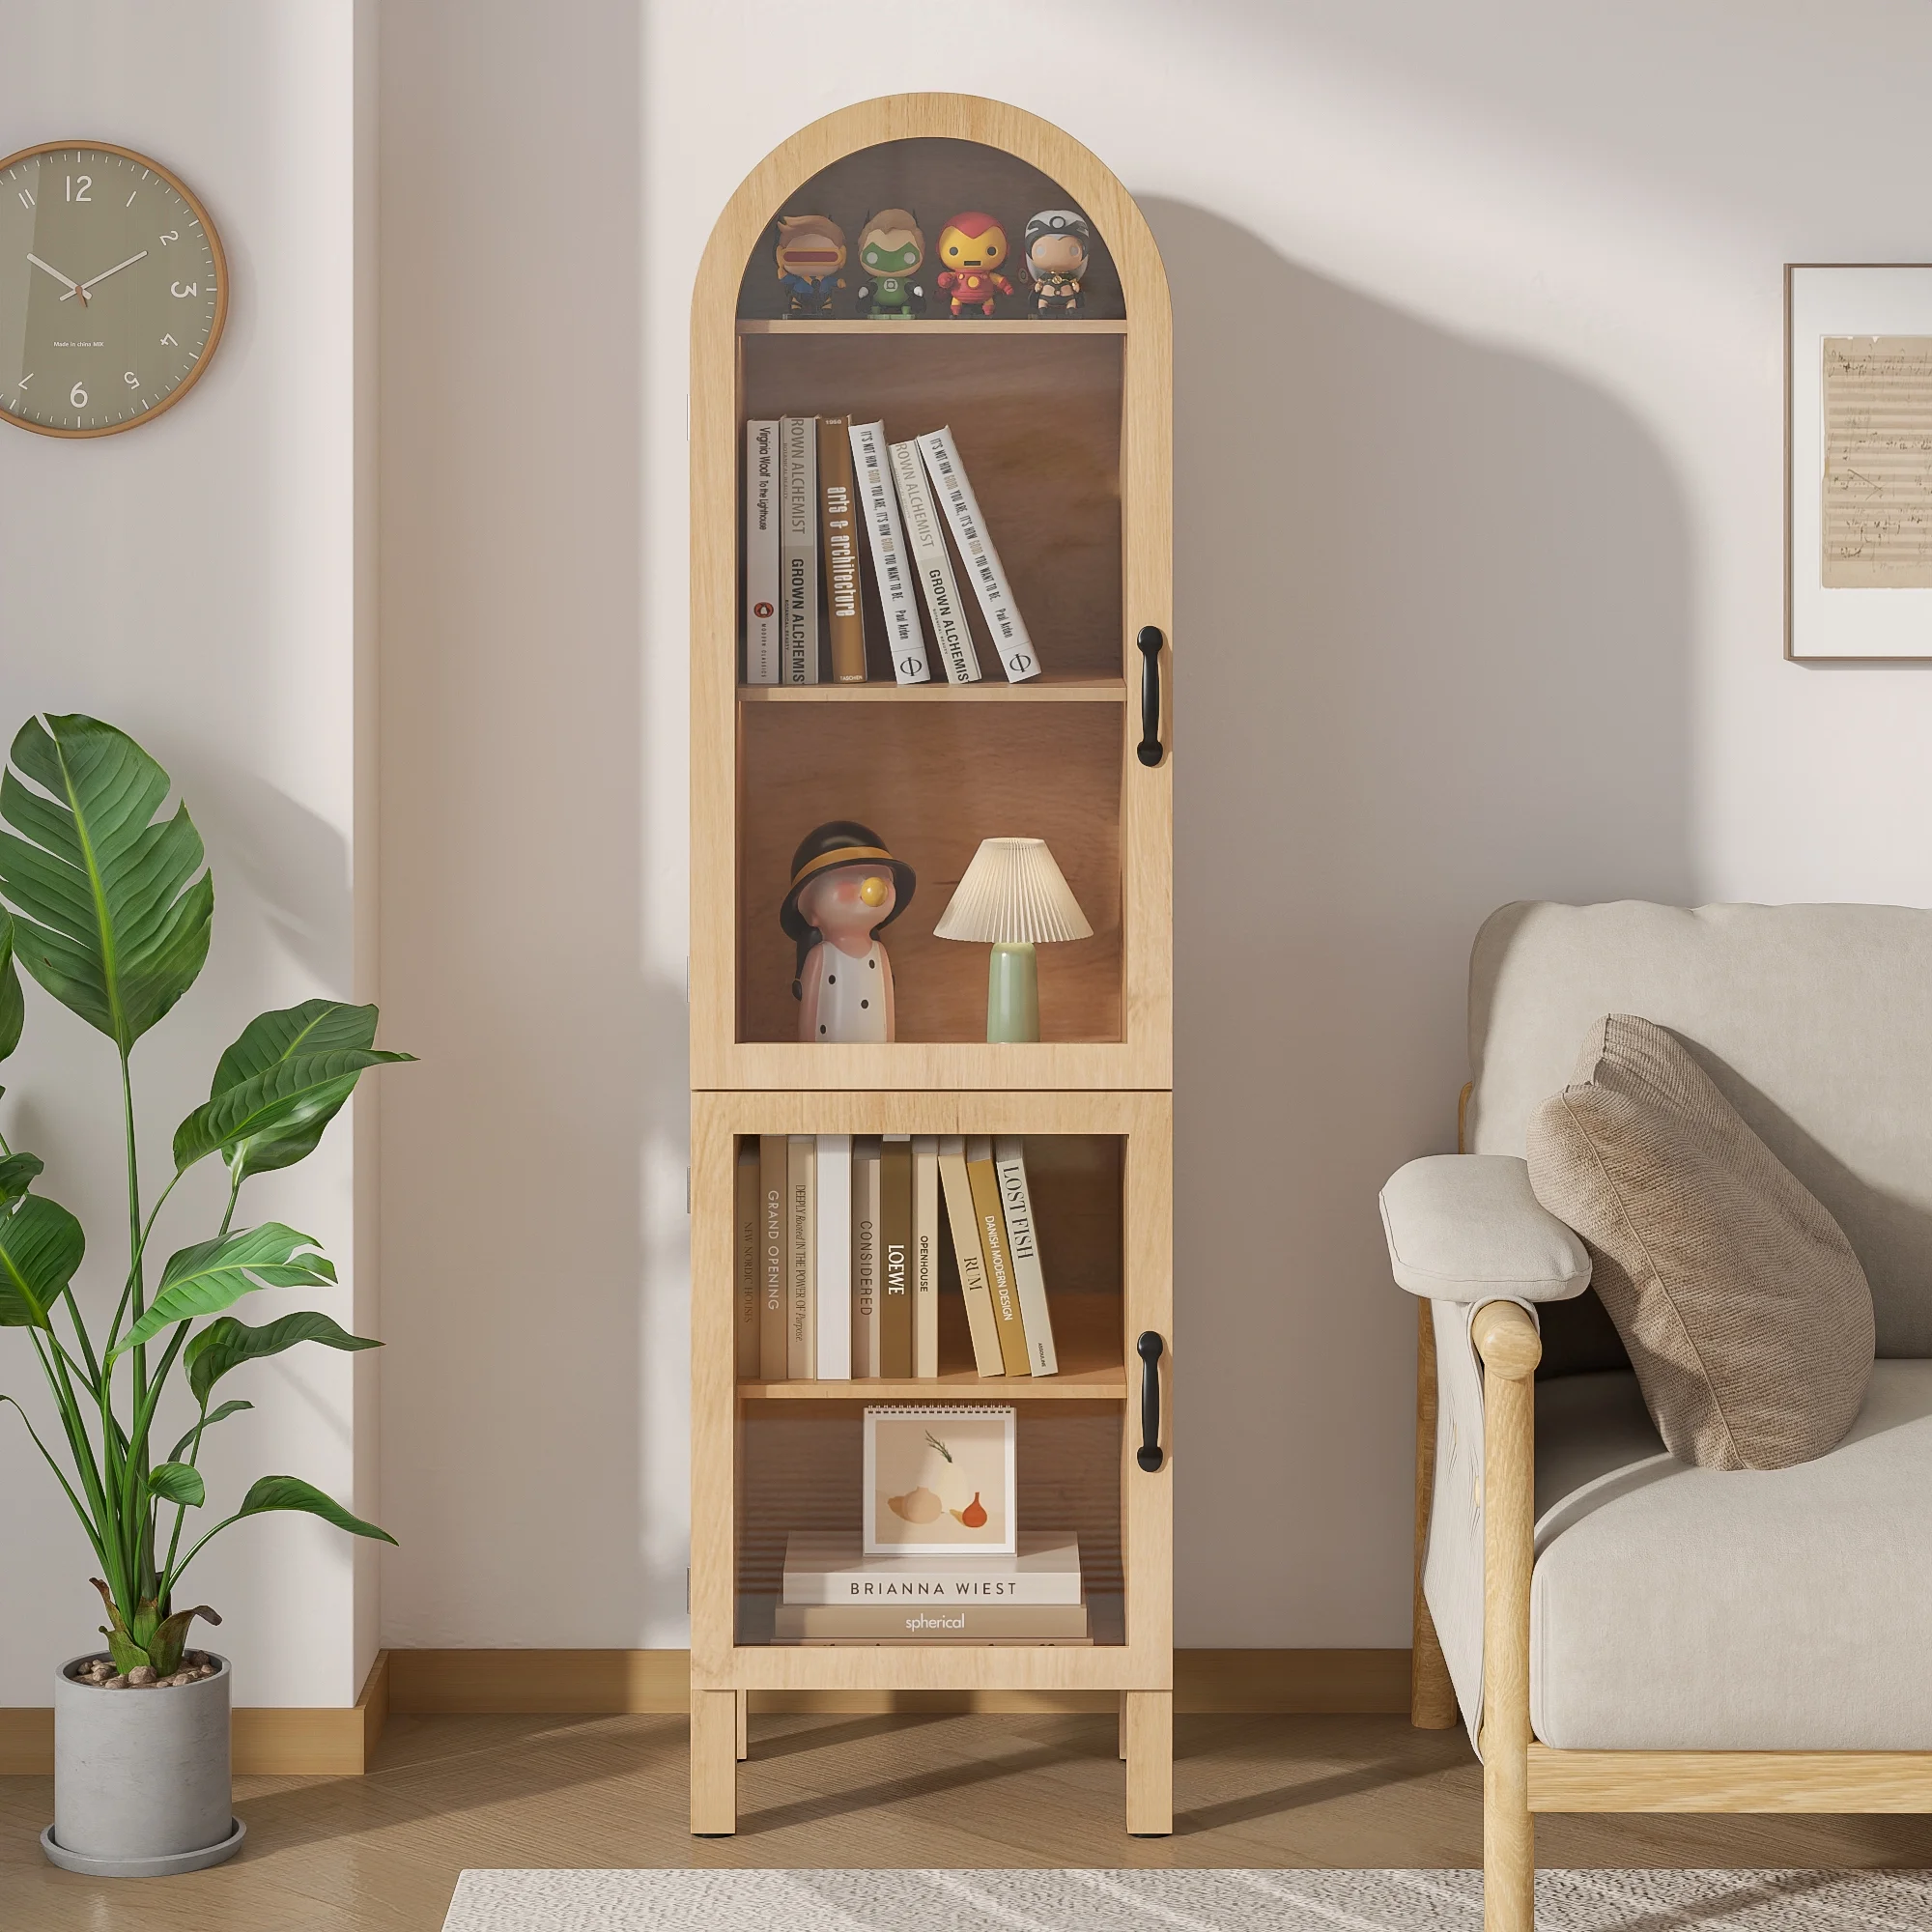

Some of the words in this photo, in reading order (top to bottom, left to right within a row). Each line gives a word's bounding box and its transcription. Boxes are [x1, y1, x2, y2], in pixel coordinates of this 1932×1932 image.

[66, 175, 92, 202] 12
[159, 230, 179, 246] 2
[170, 281, 197, 298] 3
[159, 333, 178, 347] 4
[17, 373, 34, 390] 7
[70, 381, 88, 408] 6
[124, 372, 140, 390] 5
[755, 427, 771, 454] Virginia
[758, 456, 771, 477] Woolf
[758, 488, 769, 497] the
[791, 462, 806, 534] ALCHEMIST
[827, 486, 850, 513] arts
[756, 498, 769, 530] Lighthouse
[830, 520, 848, 528] &
[905, 484, 934, 547] ALCHEMIST
[791, 558, 804, 609] GROWN
[831, 535, 856, 616] architecture
[929, 569, 952, 615] GROWN
[942, 620, 969, 681] ALCHEMIS
[791, 613, 805, 684] ALCHEMIS
[795, 1184, 806, 1213] DEEPLY
[1003, 1166, 1027, 1214] LOST
[767, 1189, 779, 1239] GRAND
[795, 1214, 806, 1240] Rooted
[743, 1221, 753, 1243] NEW
[984, 1215, 1000, 1249] DANISH
[1011, 1217, 1034, 1260] FISH
[743, 1245, 753, 1284] NORDIC
[795, 1251, 806, 1266] THE
[860, 1221, 873, 1316] CONSIDERED
[888, 1244, 905, 1295] LOEWE
[920, 1236, 928, 1293] OPENHOUSE
[991, 1248, 1007, 1288] MODERN
[767, 1245, 780, 1310] OPENING
[795, 1269, 806, 1297] POWER
[963, 1257, 983, 1292] RUM
[743, 1287, 753, 1323] HOUSES
[795, 1299, 806, 1311] OF
[998, 1287, 1013, 1321] DESIGN
[792, 1312, 806, 1343] Purpose.
[850, 1582, 945, 1595] BRIANNA
[955, 1582, 1017, 1595] WIEST
[905, 1612, 965, 1632] spherical
